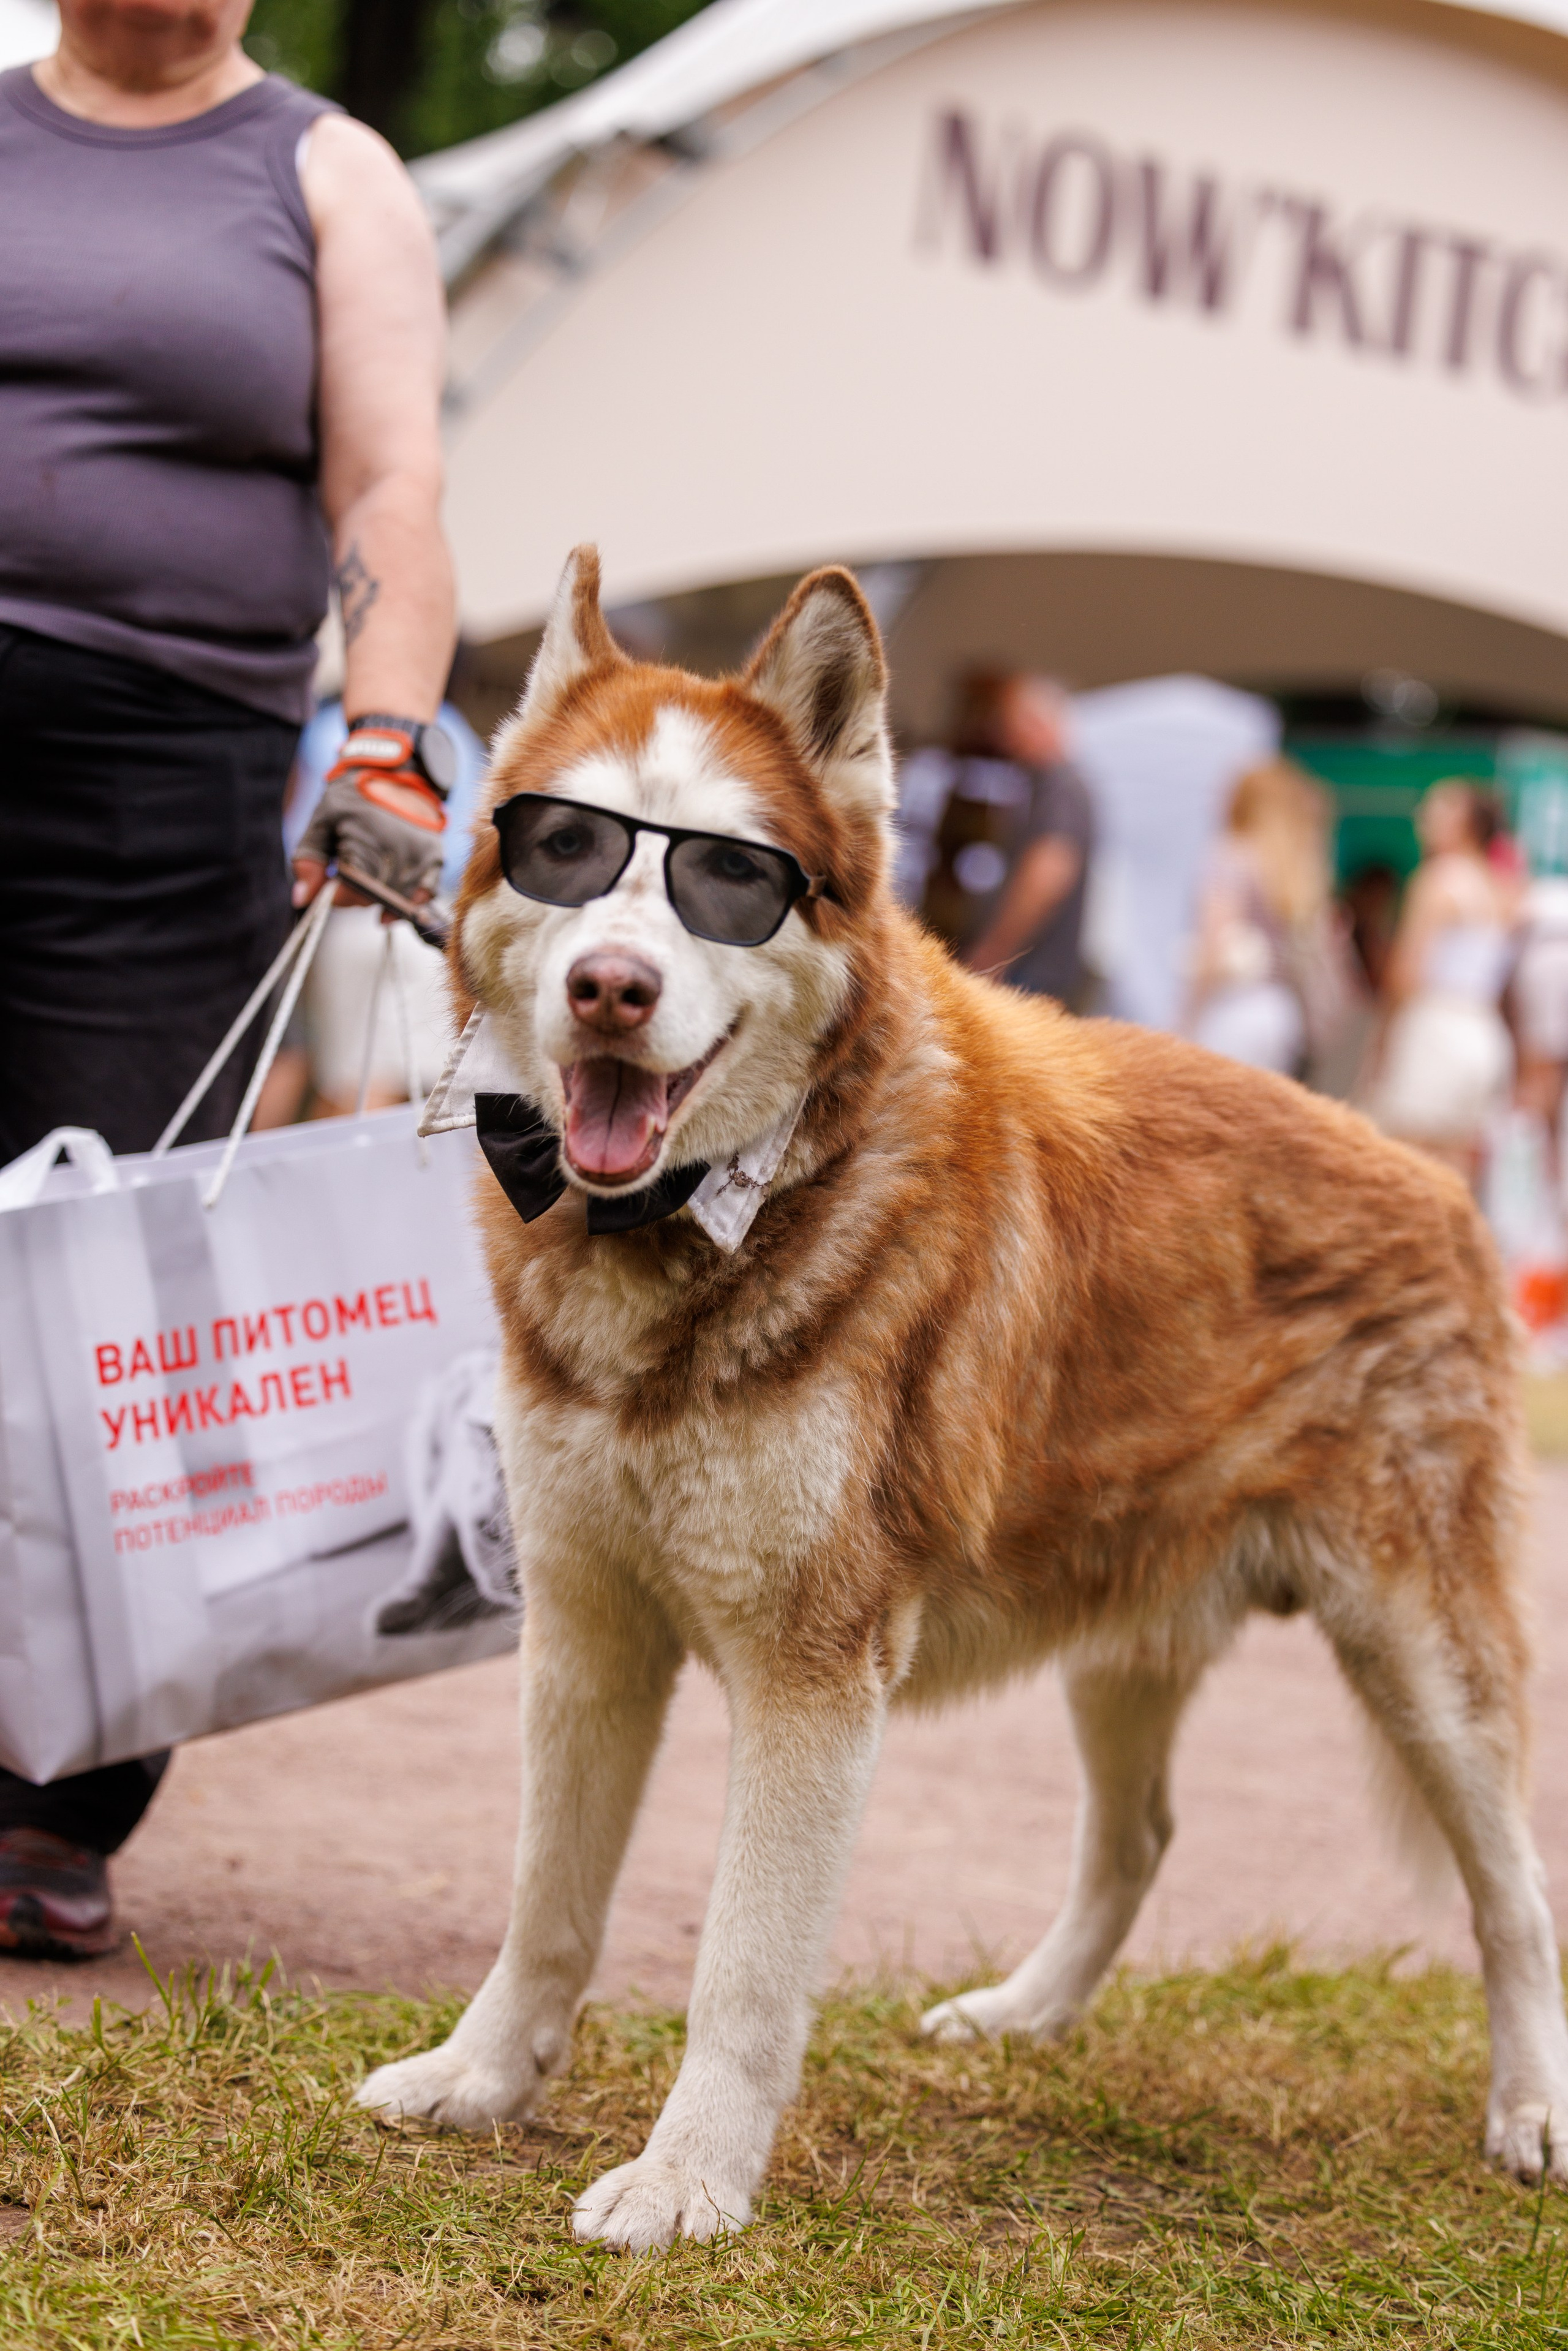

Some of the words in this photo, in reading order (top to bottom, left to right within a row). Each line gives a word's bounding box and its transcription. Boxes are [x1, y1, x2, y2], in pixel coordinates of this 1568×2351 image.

[95, 1327, 199, 1386] ВАШ
[212, 1278, 439, 1362] ПИТОМЕЦ
[101, 1360, 353, 1450] УНИКАЛЕН
[111, 1460, 257, 1515] РАСКРОЙТЕ
[115, 1497, 271, 1555] ПОТЕНЦИАЛ
[276, 1472, 388, 1514] ПОРОДЫ
